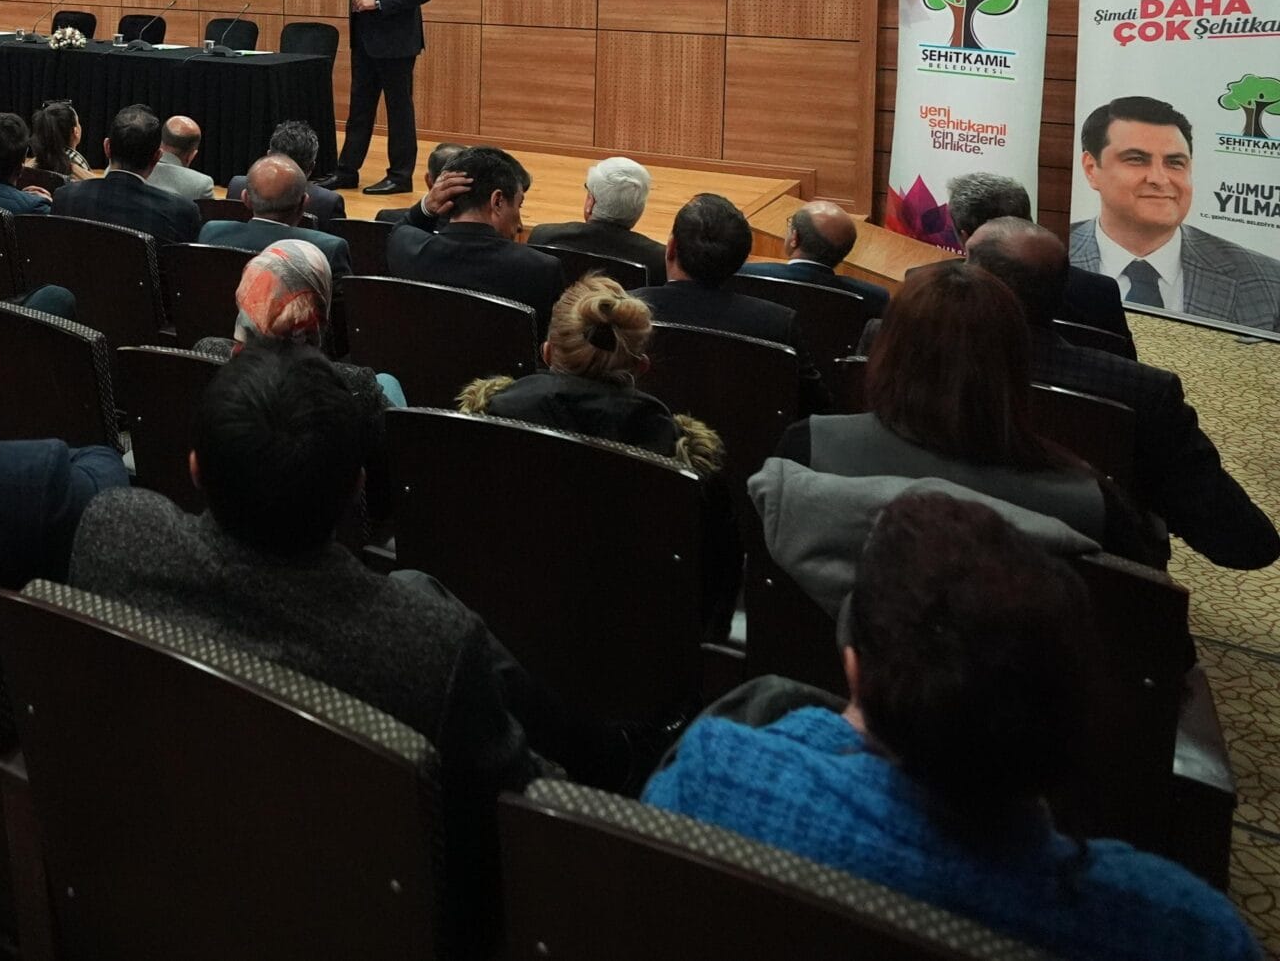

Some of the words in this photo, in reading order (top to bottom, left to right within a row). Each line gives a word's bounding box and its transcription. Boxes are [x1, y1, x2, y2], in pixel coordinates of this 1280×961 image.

[1094, 8, 1138, 25] Şimdi
[1113, 20, 1192, 46] ÇOK
[1194, 16, 1280, 39] Şehitka
[920, 105, 951, 119] yeni
[958, 131, 1006, 147] sizlerle
